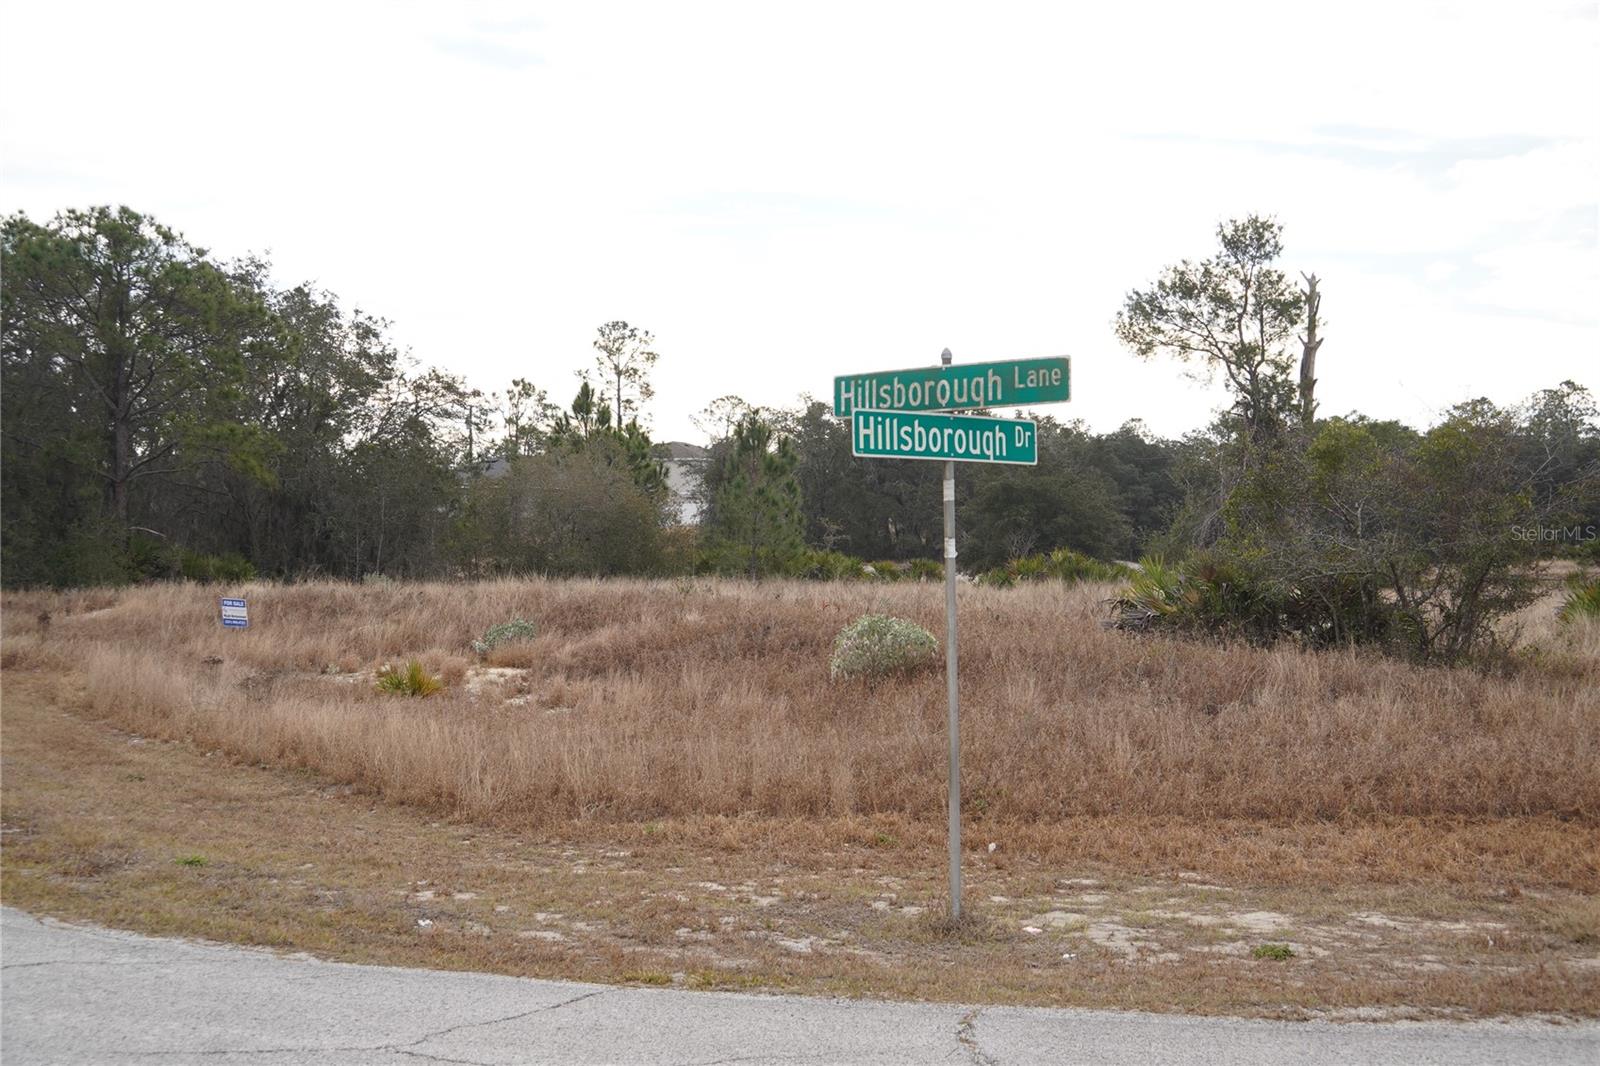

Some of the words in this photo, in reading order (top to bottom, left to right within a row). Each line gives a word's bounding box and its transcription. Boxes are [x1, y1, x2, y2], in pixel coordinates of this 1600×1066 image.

[840, 368, 1003, 412] Hillsborough
[1014, 366, 1062, 388] Lane
[858, 415, 1006, 461] Hillsborough
[1015, 426, 1032, 448] Dr
